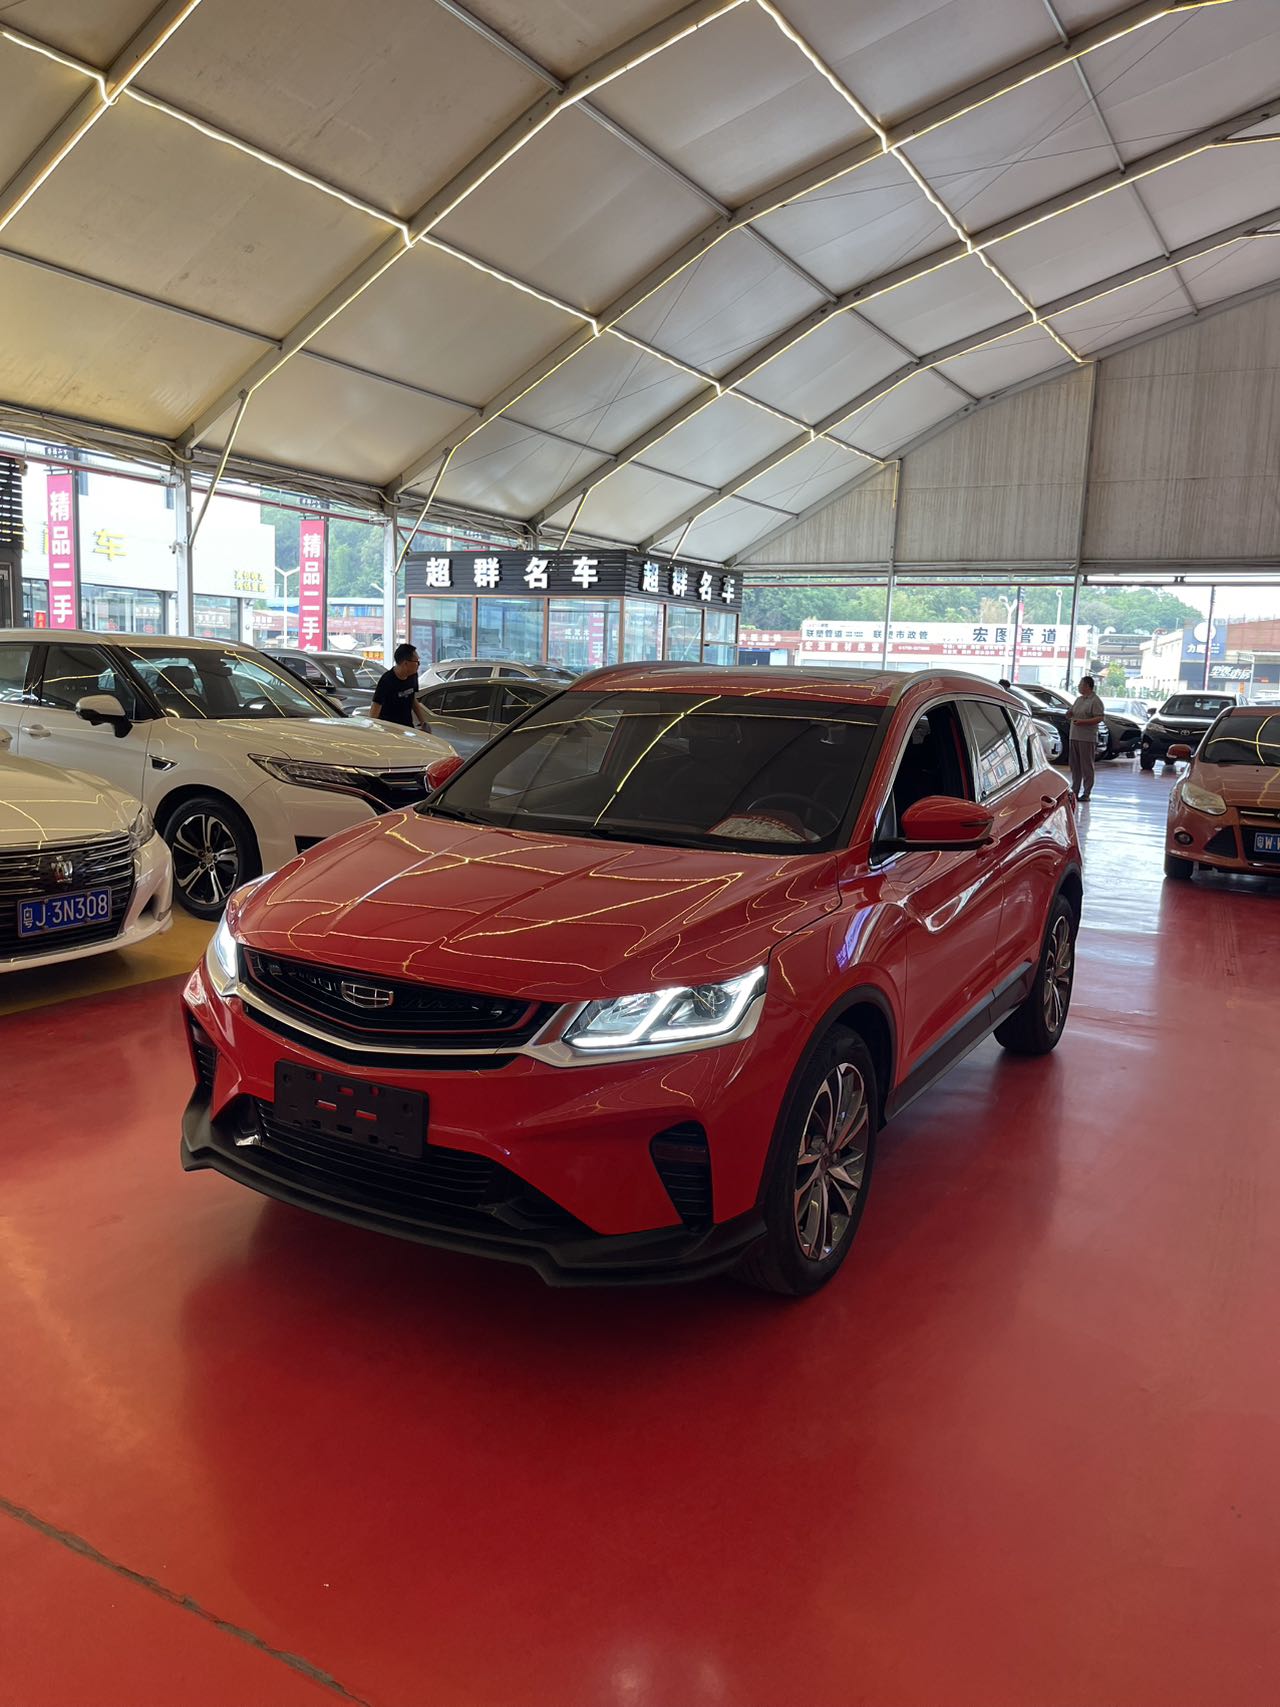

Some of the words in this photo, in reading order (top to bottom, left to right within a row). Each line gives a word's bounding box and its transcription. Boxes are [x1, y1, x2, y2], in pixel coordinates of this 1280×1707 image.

[49, 491, 73, 624] 精品二手
[426, 556, 599, 589] 超群名车
[642, 561, 735, 603] 超群名车
[973, 627, 1057, 644] 宏图管道
